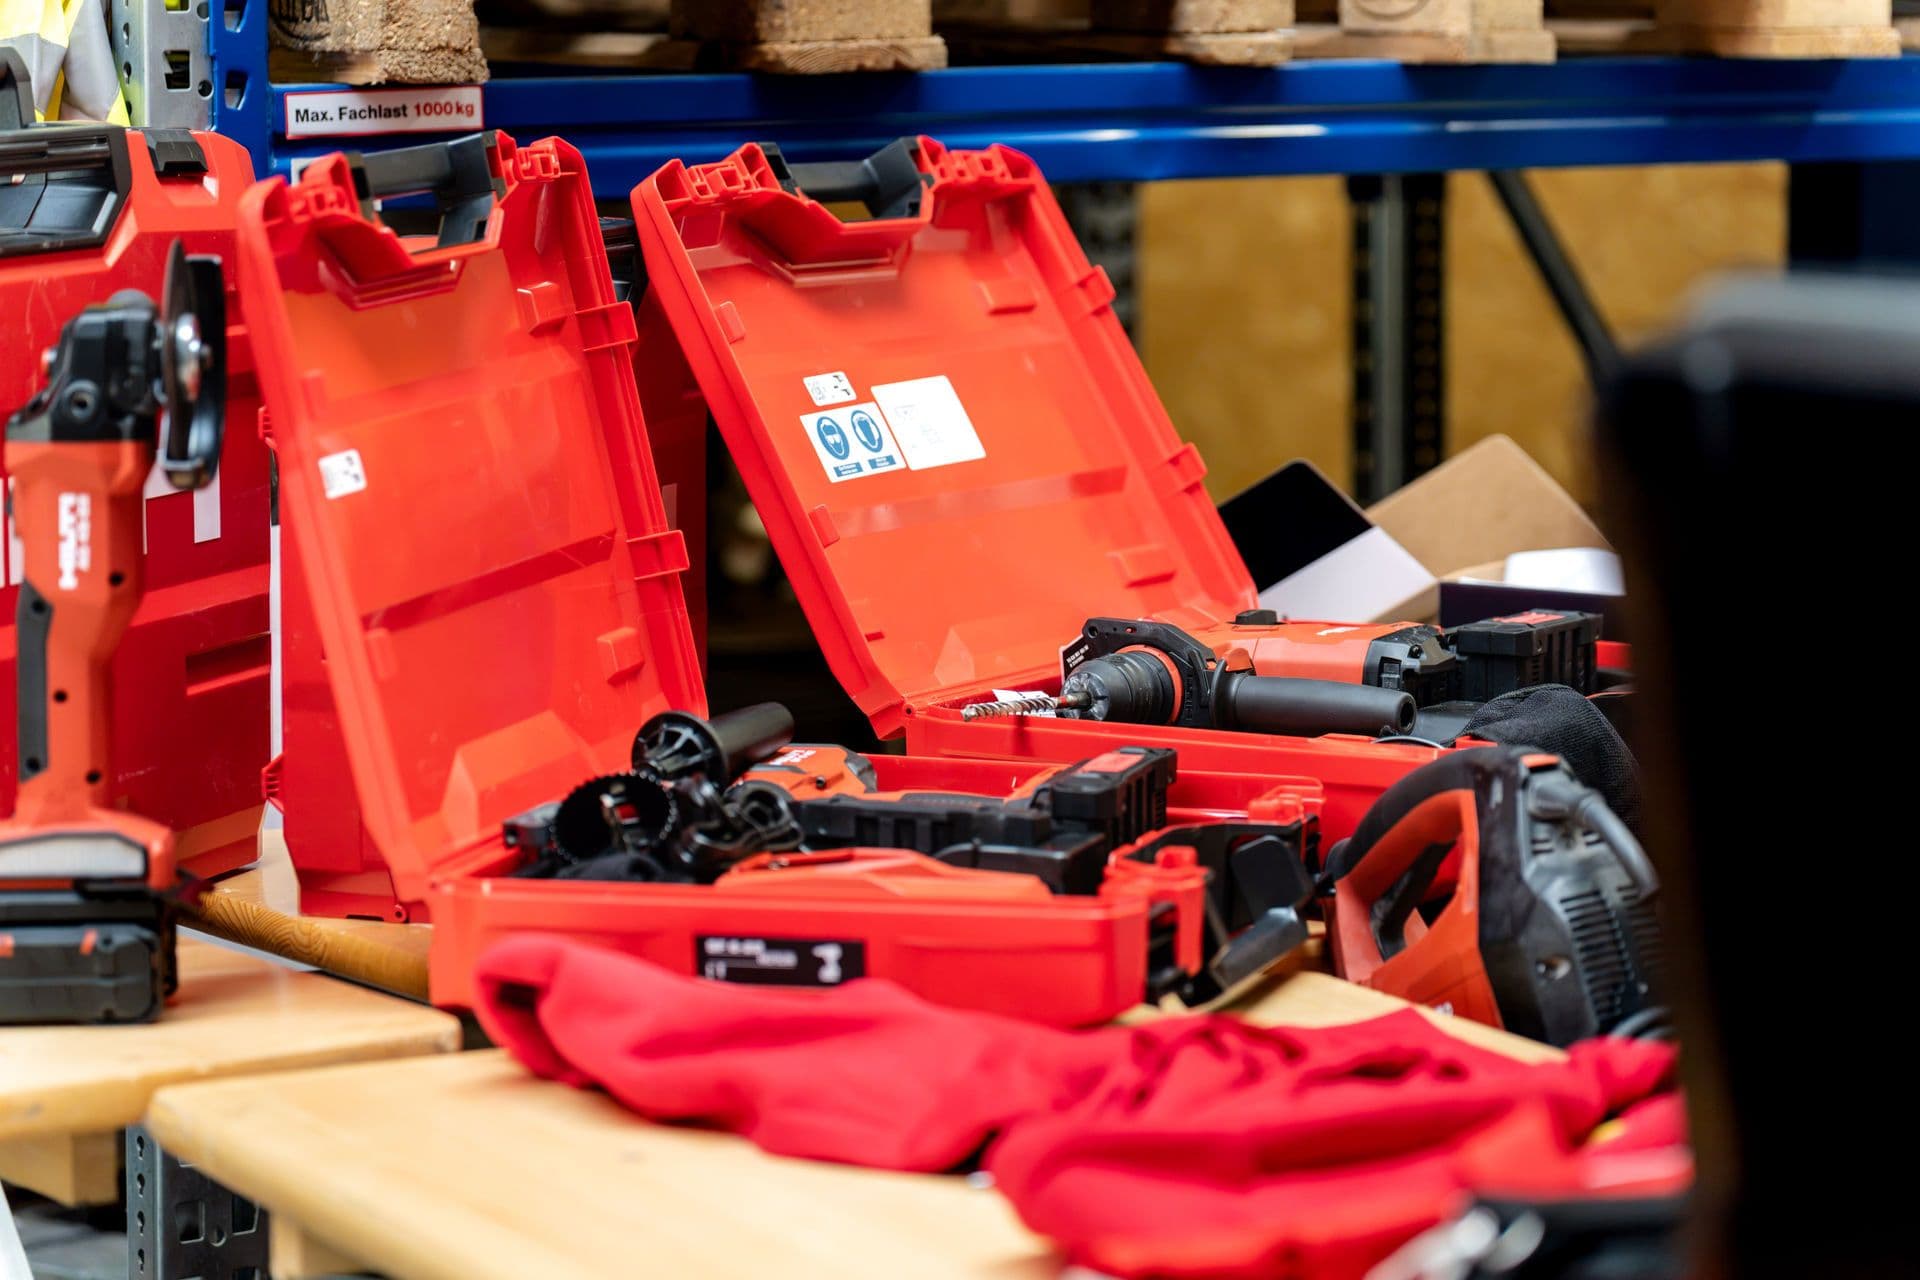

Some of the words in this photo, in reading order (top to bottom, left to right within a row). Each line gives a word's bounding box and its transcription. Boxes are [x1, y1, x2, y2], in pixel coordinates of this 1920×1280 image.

[295, 108, 334, 123] Max.
[338, 104, 408, 121] Fachlast
[414, 102, 452, 117] 1000
[455, 101, 475, 117] kg
